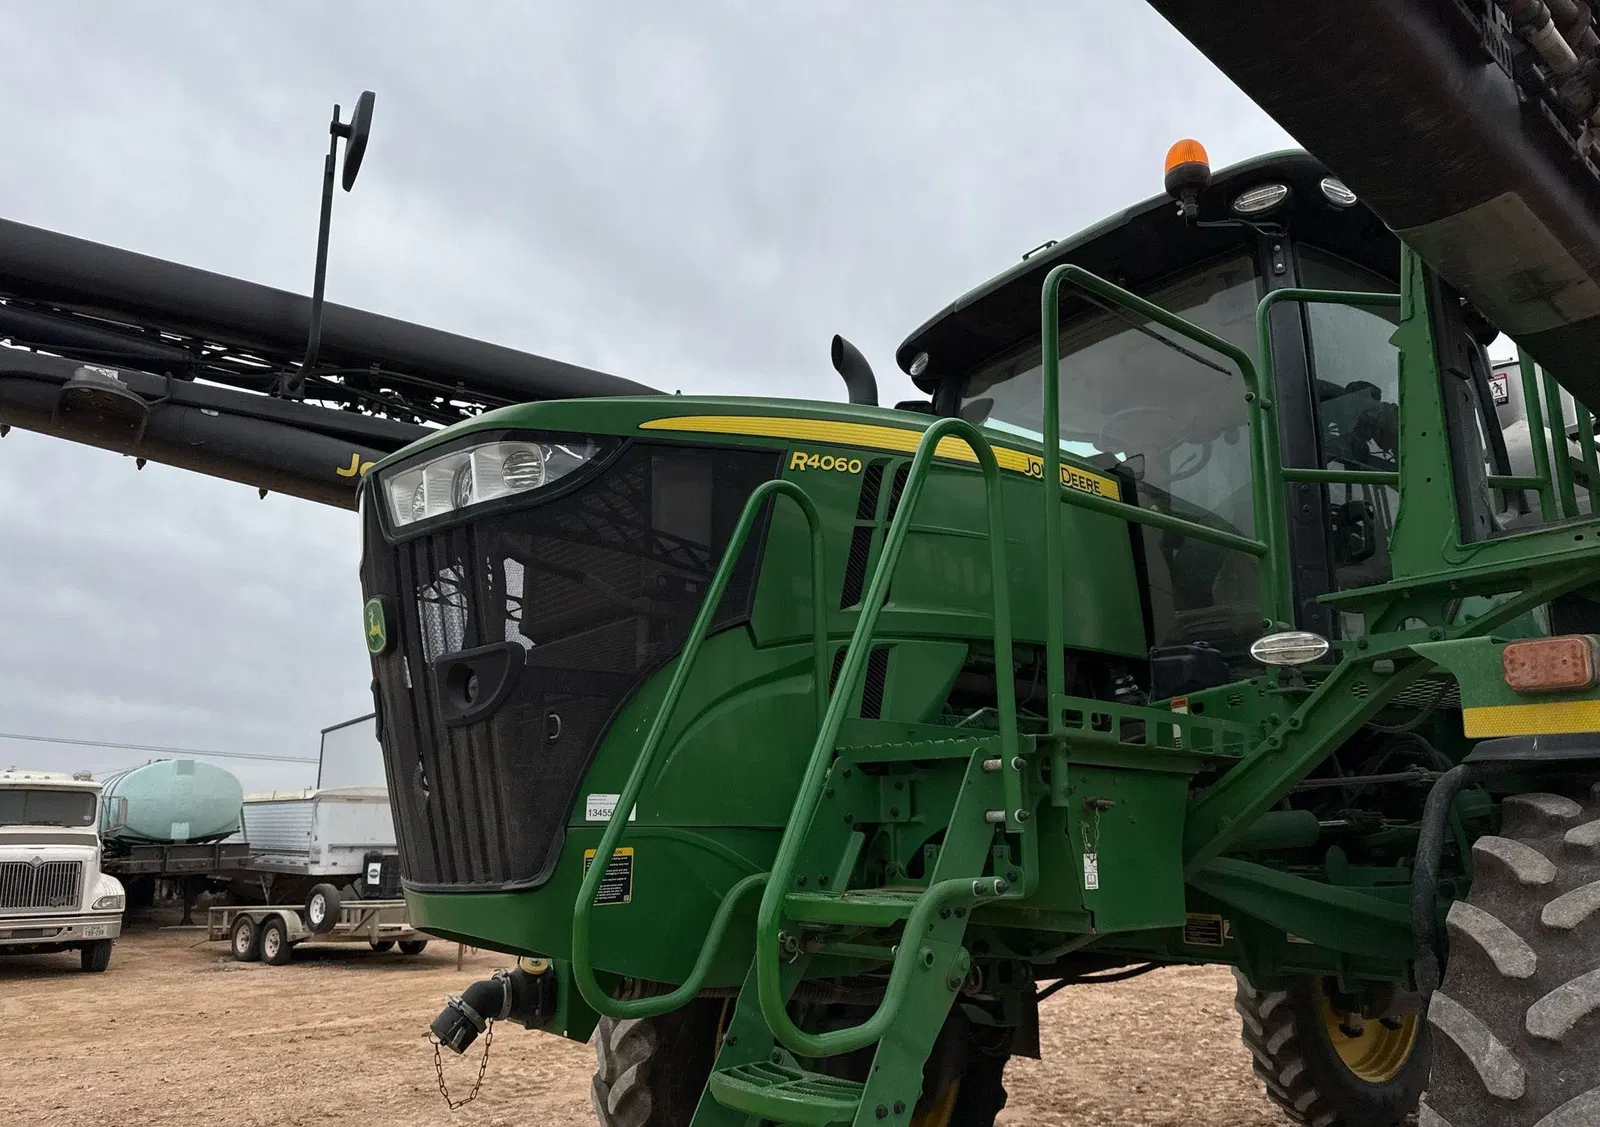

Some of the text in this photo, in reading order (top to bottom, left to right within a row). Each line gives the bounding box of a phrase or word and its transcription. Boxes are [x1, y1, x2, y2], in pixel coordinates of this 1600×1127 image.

[789, 451, 862, 474] R4060
[1023, 457, 1102, 494] JO DEERE
